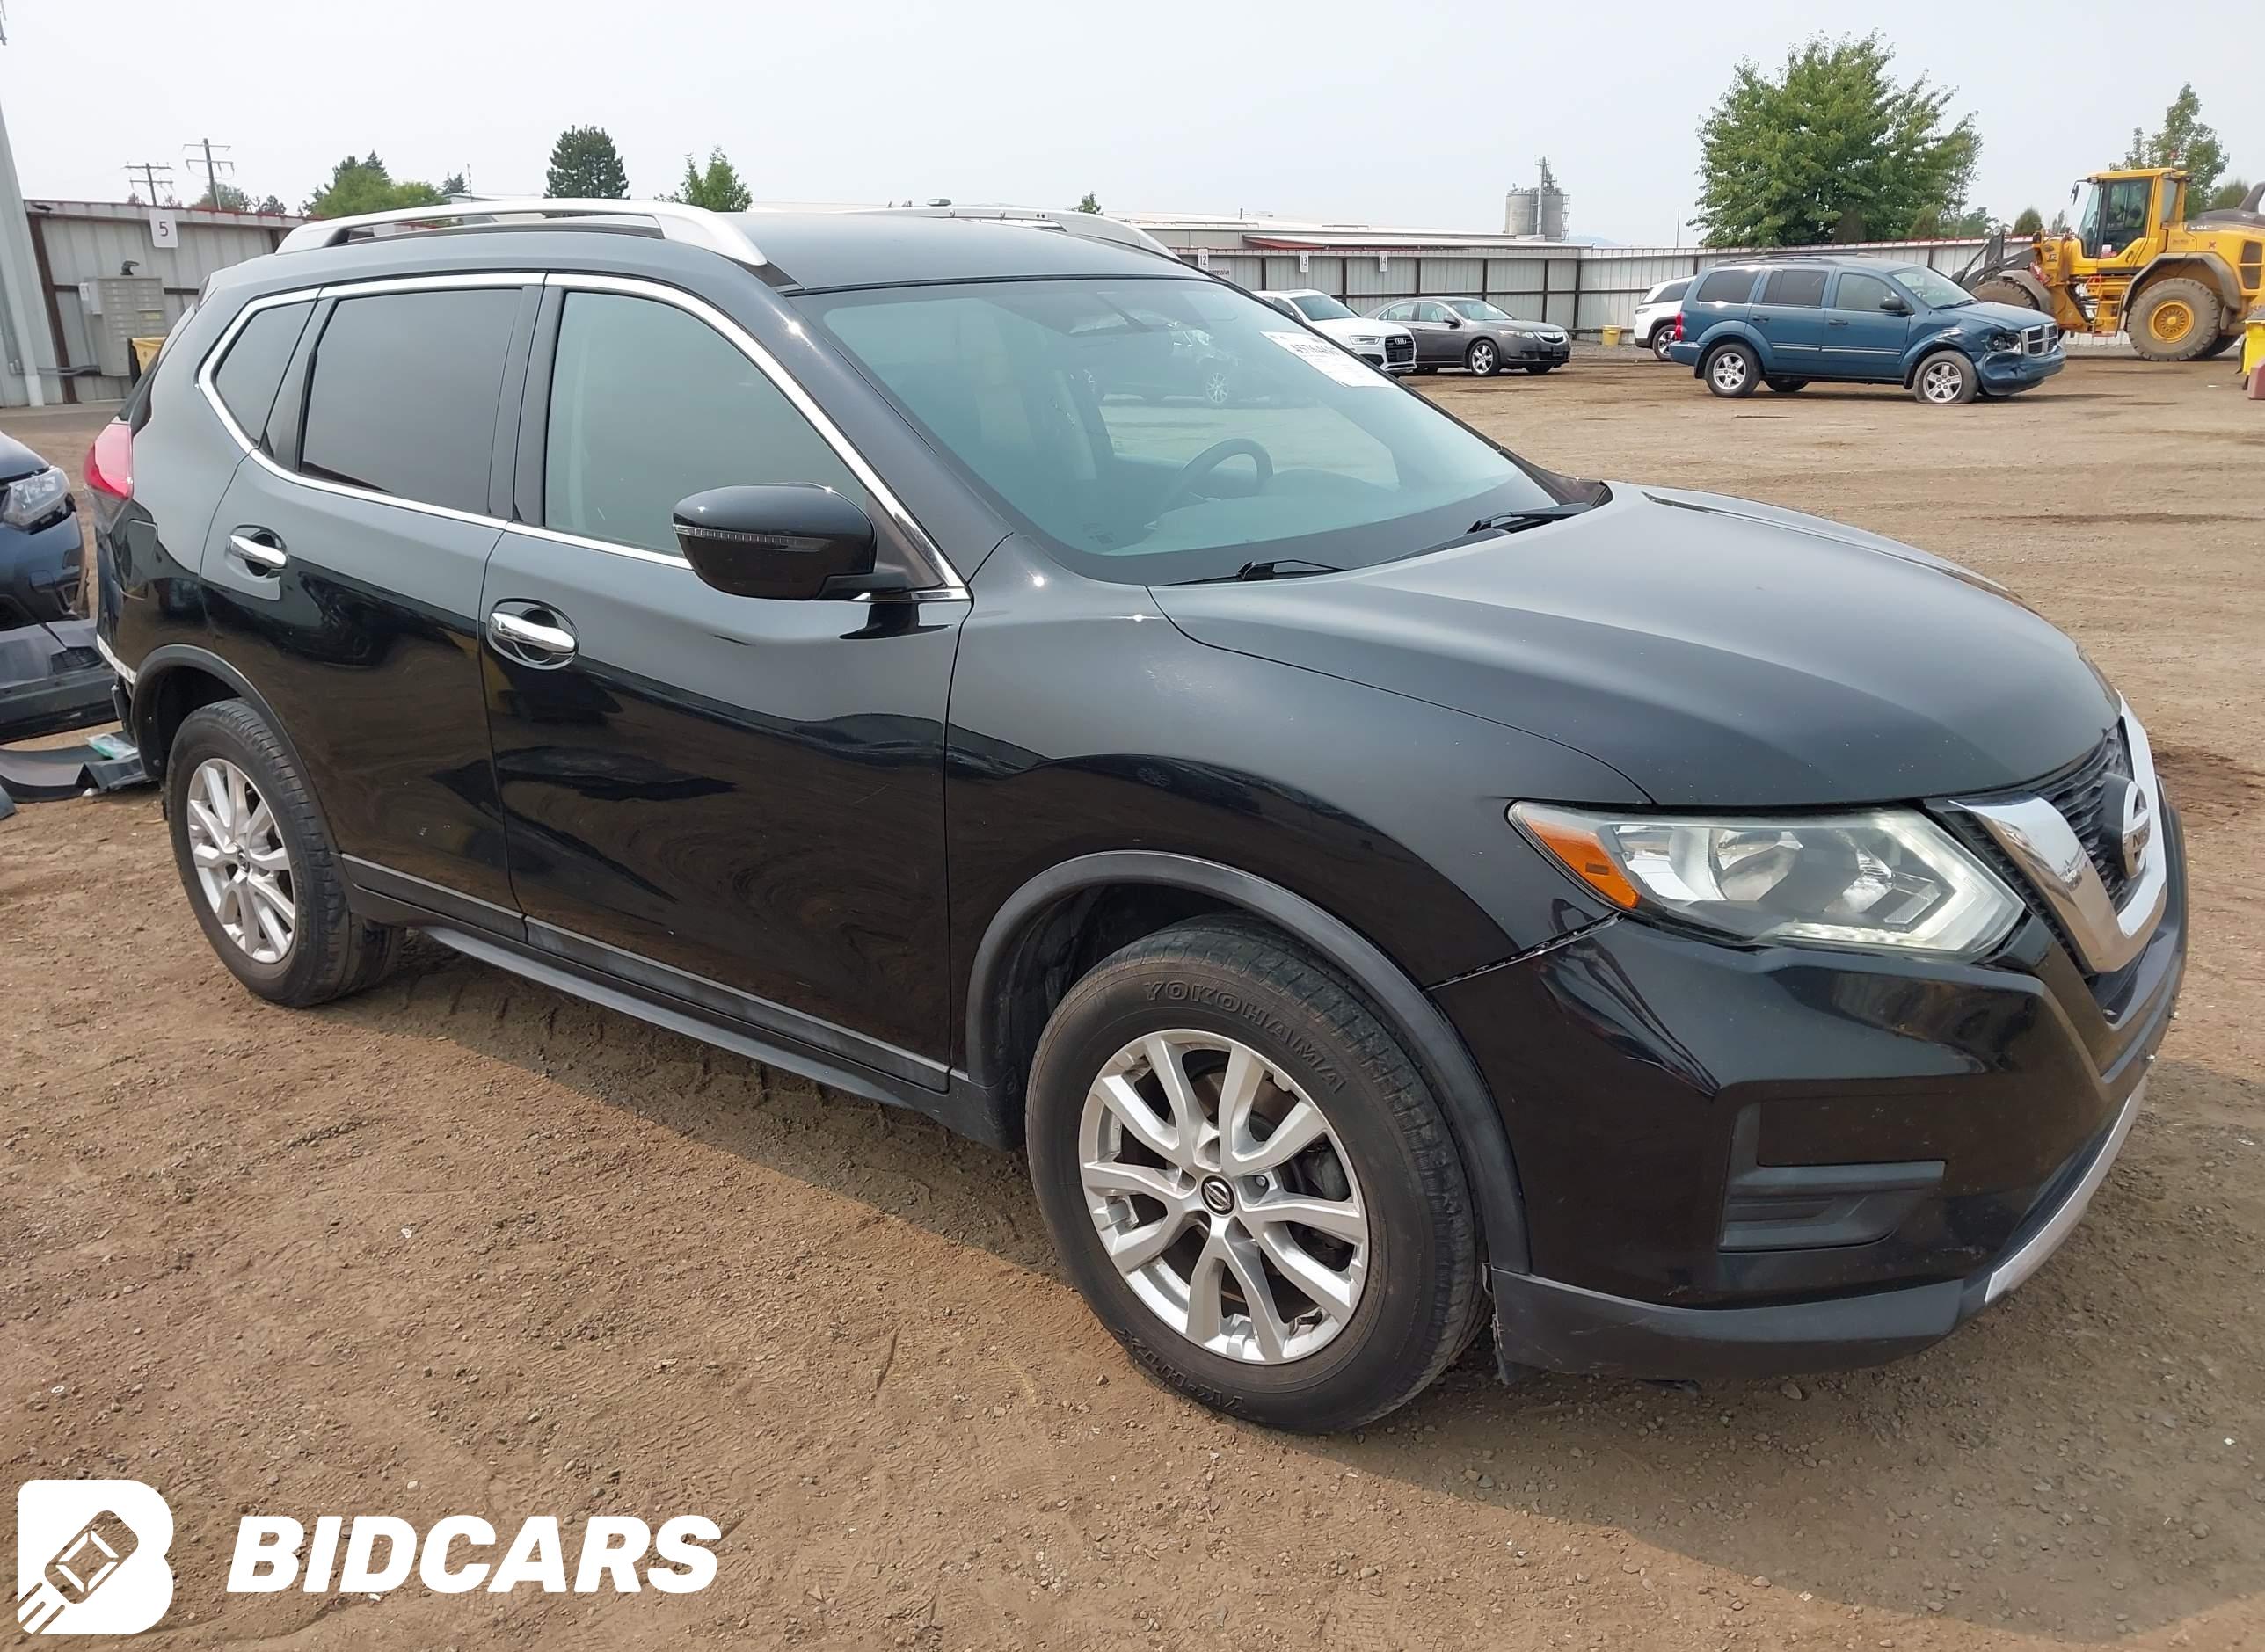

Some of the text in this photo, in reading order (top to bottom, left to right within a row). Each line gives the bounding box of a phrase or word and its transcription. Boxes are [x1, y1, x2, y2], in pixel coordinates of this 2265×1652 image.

[159, 221, 169, 237] 5
[1200, 255, 1207, 266] 12
[1300, 256, 1308, 266] 13
[1380, 256, 1387, 266] 14
[1144, 980, 1346, 1093] YOKOHAMA
